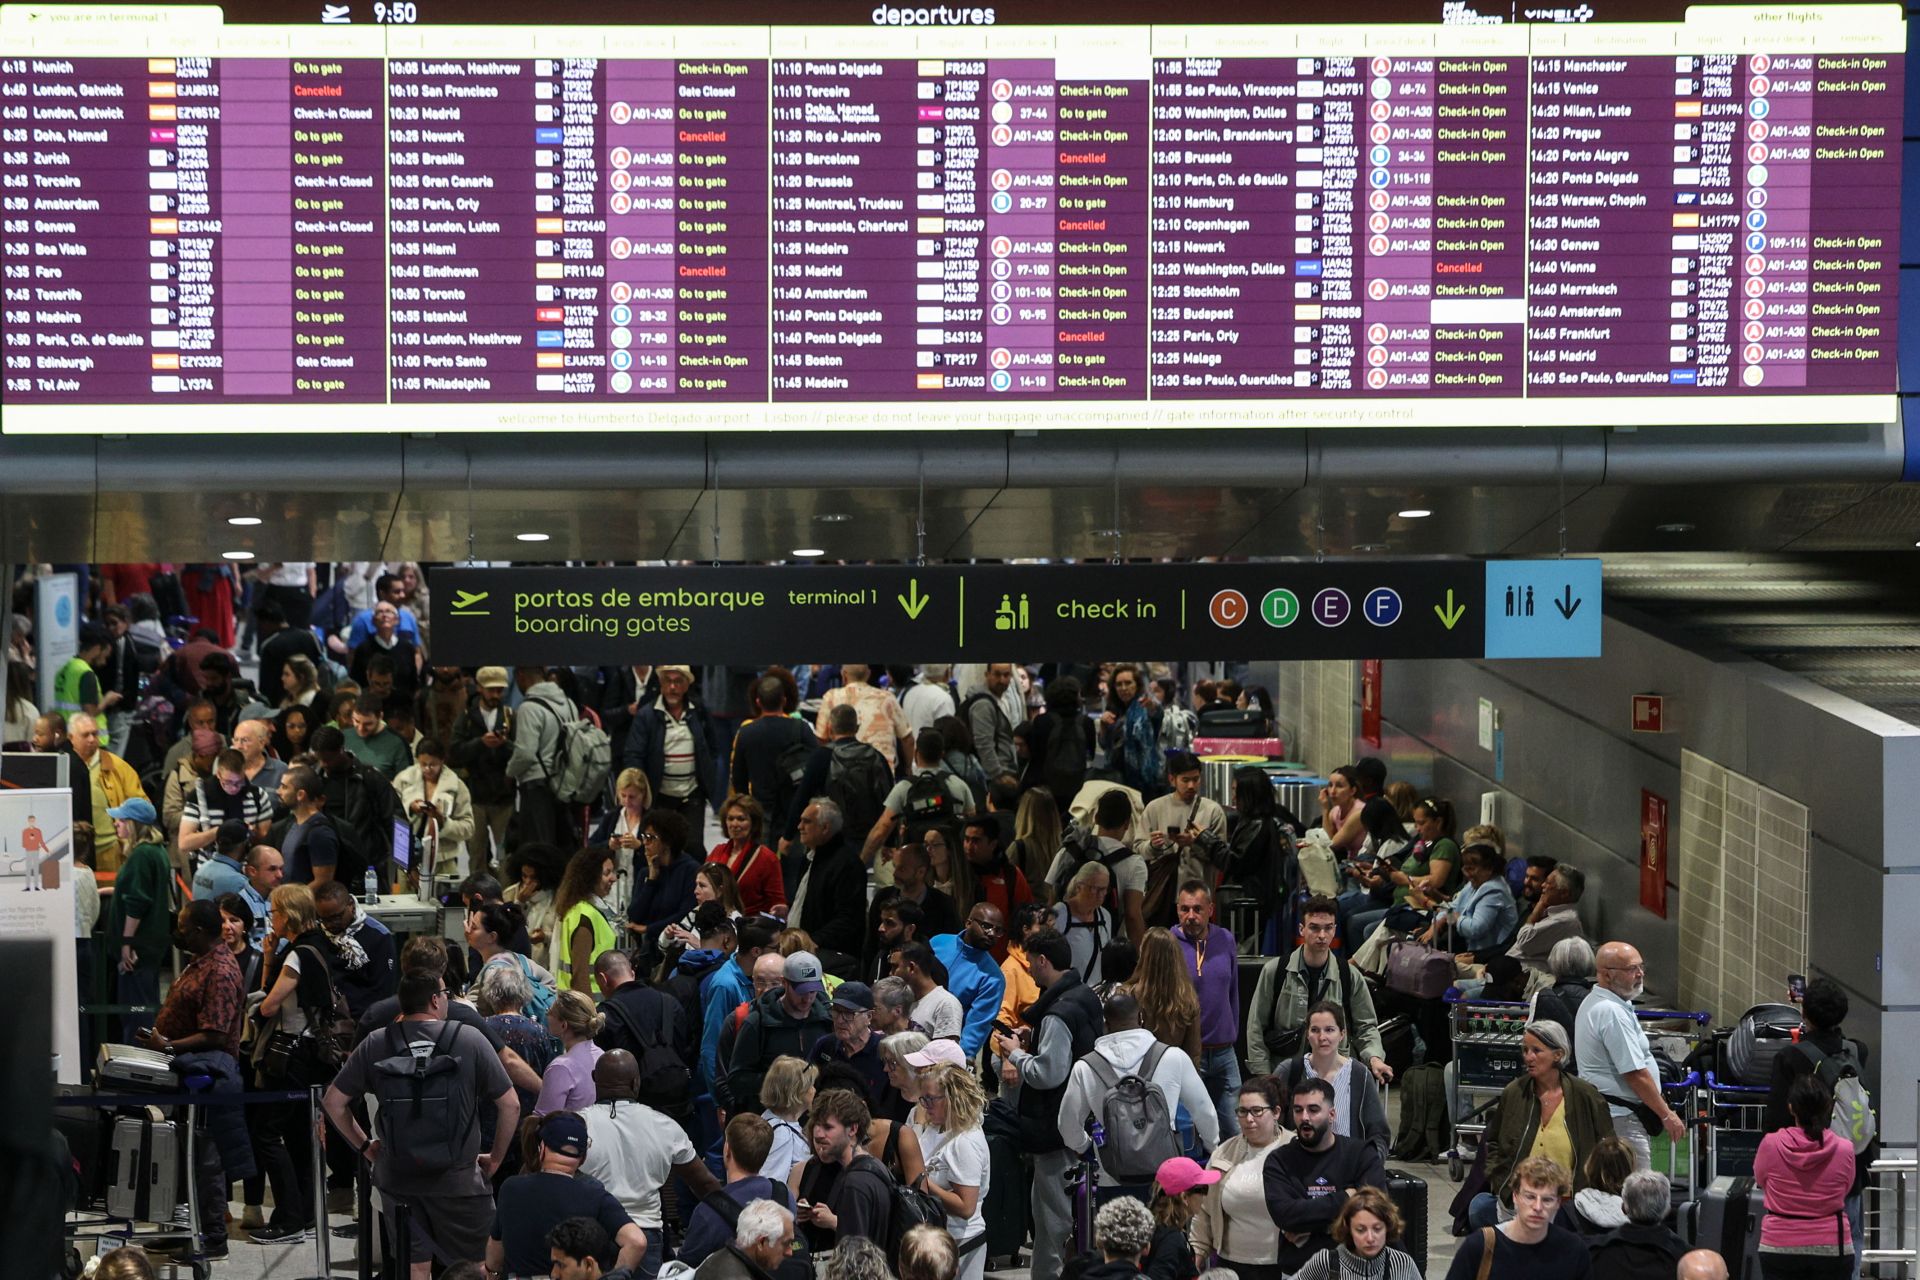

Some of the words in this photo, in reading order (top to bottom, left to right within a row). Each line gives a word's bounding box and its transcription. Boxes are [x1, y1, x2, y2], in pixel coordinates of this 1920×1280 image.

[50, 13, 70, 22] you
[74, 13, 92, 22] are
[109, 12, 159, 22] terminal
[374, 2, 417, 24] 9:50
[872, 4, 996, 27] departures
[1753, 12, 1784, 23] other
[1787, 11, 1824, 24] flights
[33, 61, 73, 73] Munich
[1564, 60, 1627, 72] Manchester
[1772, 59, 1812, 69] A01-A30
[1818, 58, 1860, 69] Check-in
[1862, 58, 1886, 71] Open
[295, 85, 342, 96] Cancelled
[422, 84, 443, 97] San
[445, 84, 498, 97] Francisco
[679, 86, 701, 97] Gate
[703, 85, 735, 97] Closed
[1014, 85, 1054, 96] A01-A30
[1060, 85, 1102, 96] Check-in
[1104, 85, 1128, 98] Open
[294, 107, 337, 119] Check-in
[339, 108, 372, 119] Closed
[422, 107, 460, 120] Madrid
[633, 108, 673, 119] A01-A30
[679, 108, 692, 119] Go
[694, 109, 704, 119] to
[706, 110, 726, 121] gate
[1185, 106, 1250, 121] Washington,
[1253, 106, 1287, 118] Dulles
[1564, 105, 1595, 118] Milan,
[1599, 105, 1631, 116] Linate
[679, 131, 726, 142] Cancelled
[805, 130, 823, 142] Rio
[825, 130, 838, 142] de
[841, 130, 881, 142] Janeiro
[805, 153, 859, 165] Barcelona
[1060, 153, 1106, 163] Cancelled
[1020, 197, 1047, 208] 20-27
[1561, 194, 1606, 207] Warsaw,
[1610, 194, 1646, 208] Chopin
[1060, 220, 1105, 230] Cancelled
[1184, 219, 1249, 233] Copenhagen
[36, 243, 57, 255] Boa
[59, 243, 86, 255] Vista
[423, 243, 456, 255] Miami
[1770, 238, 1806, 248] 109-114
[296, 244, 309, 254] Go
[311, 245, 321, 254] to
[322, 245, 343, 257] gate
[423, 265, 479, 277] Eindhoven
[680, 266, 726, 276] Cancelled
[1017, 265, 1049, 275] 97-100
[1437, 263, 1482, 272] Cancelled
[1560, 261, 1596, 273] Vienna
[35, 288, 82, 300] Tenerife
[423, 288, 465, 300] Toronto
[805, 287, 867, 299] Amsterdam
[1184, 285, 1240, 297] Stockholm
[640, 311, 667, 321] 28-32
[1184, 308, 1233, 321] Budapest
[640, 333, 667, 343] 77-80
[1059, 332, 1104, 341] Cancelled
[1184, 330, 1214, 342] Paris,
[1217, 330, 1239, 344] Orly
[1390, 329, 1429, 340] A01-A30
[1436, 329, 1477, 339] Check-in
[1479, 329, 1503, 341] Open
[1560, 328, 1610, 339] Frankfurt
[1812, 326, 1853, 336] Check-in
[1856, 326, 1879, 338] Open
[424, 333, 466, 346] London,
[469, 333, 522, 344] Heathrow
[37, 356, 94, 371] Edinburgh
[296, 356, 319, 367] Gate
[320, 356, 353, 367] Closed
[424, 355, 453, 367] Porto
[456, 355, 487, 367] Santo
[680, 355, 721, 365] Check-in
[724, 355, 748, 368] Open
[805, 354, 842, 366] Boston
[1059, 354, 1071, 364] Go
[1074, 355, 1083, 364] to
[1085, 355, 1105, 366] gate
[498, 413, 557, 424] welcome
[561, 413, 573, 424] to
[578, 412, 644, 424] Humberto
[648, 412, 702, 426] Delgado
[706, 412, 750, 426] airport
[764, 411, 807, 424] Lisbon
[826, 412, 868, 426] please
[872, 411, 888, 423] do
[893, 412, 912, 423] not
[917, 411, 952, 423] leave
[955, 413, 983, 426] your
[987, 411, 1042, 426] baggage
[1047, 410, 1149, 425] unaccompanied
[1167, 411, 1195, 424] gate
[1199, 409, 1274, 422] information
[1278, 409, 1307, 421] after
[1313, 408, 1364, 423] security
[1368, 408, 1414, 421] control
[514, 589, 594, 613] portas
[600, 588, 632, 608] de
[638, 588, 765, 612] embarque
[788, 589, 865, 605] terminal
[870, 590, 877, 604] 1
[1056, 598, 1129, 619] check
[1137, 598, 1157, 619] in
[1221, 597, 1237, 620] C
[1273, 597, 1290, 619] D
[1323, 596, 1339, 618] E
[1376, 595, 1391, 618] F
[515, 613, 619, 638] boarding
[626, 614, 691, 638] gates
